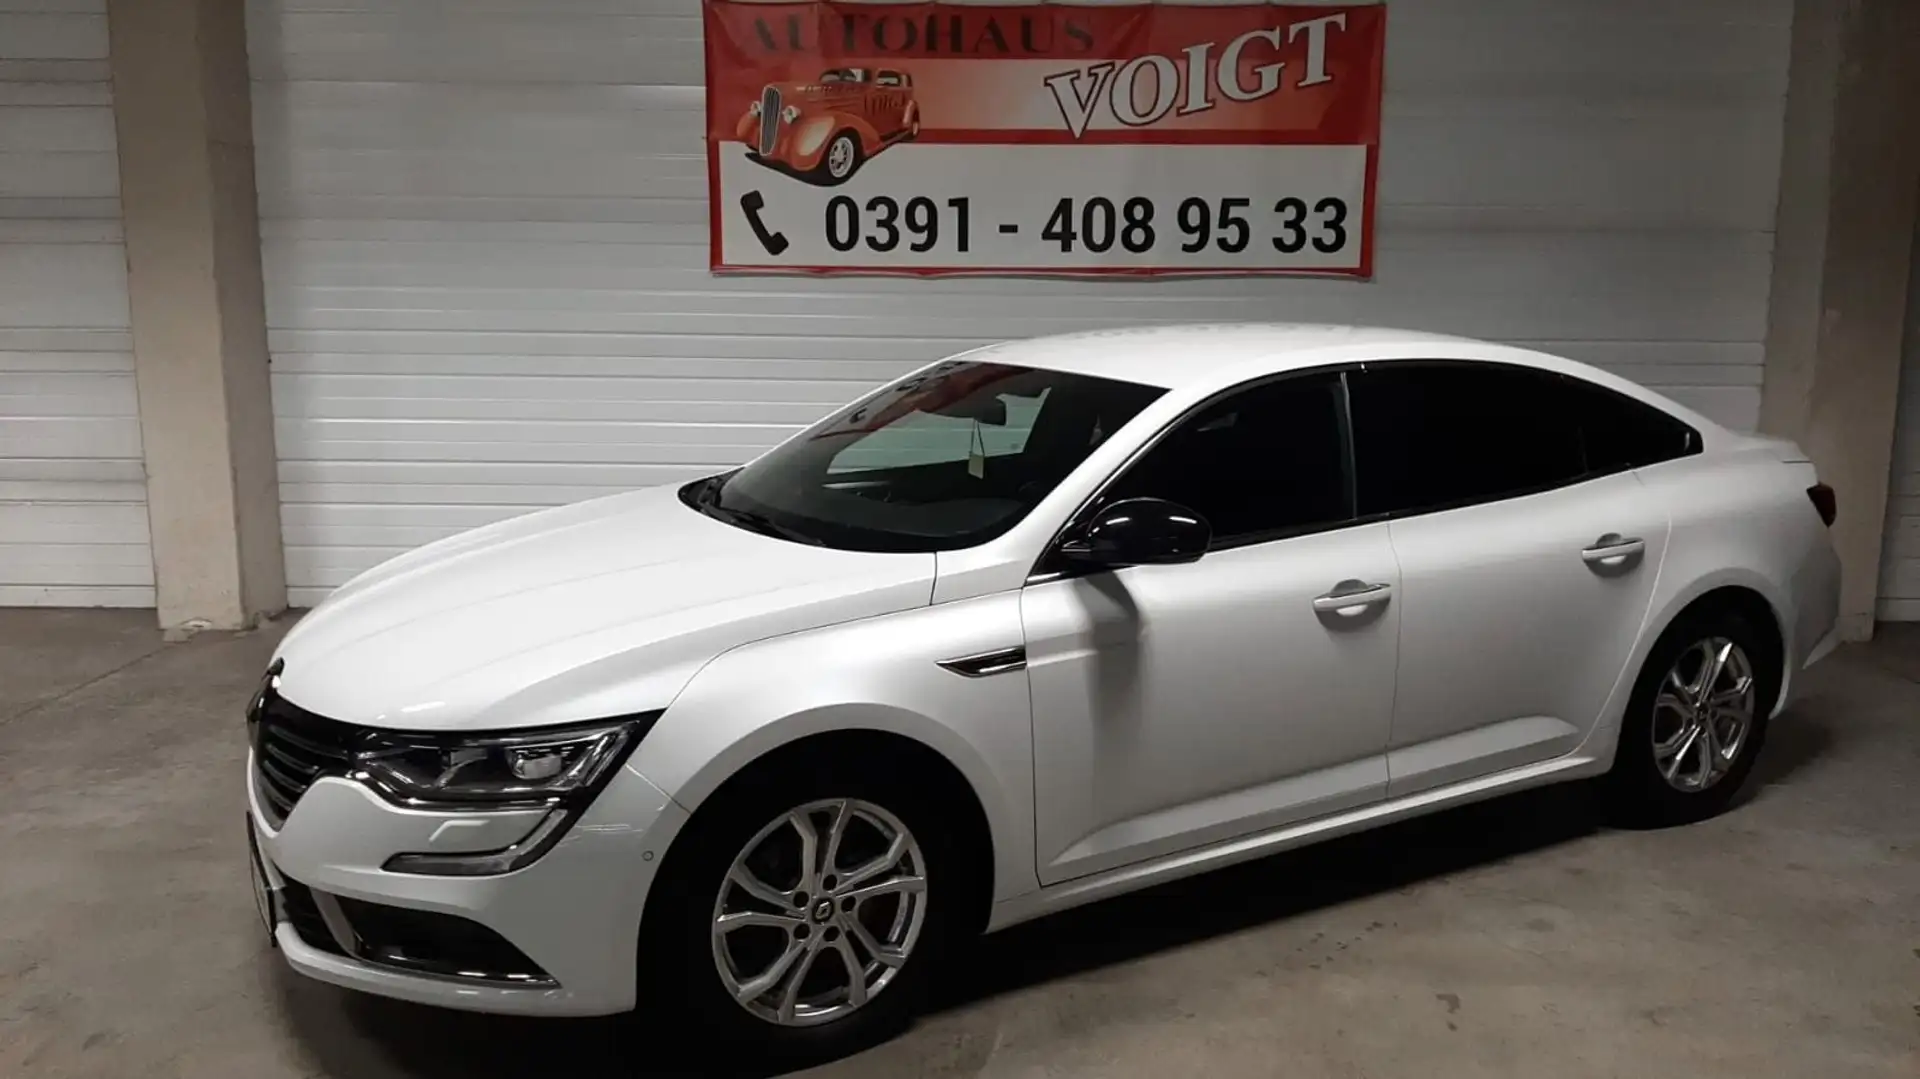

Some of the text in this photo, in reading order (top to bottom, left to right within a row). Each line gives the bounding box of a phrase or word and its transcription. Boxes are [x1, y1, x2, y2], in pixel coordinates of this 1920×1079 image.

[746, 14, 1095, 54] AUTOHAUS
[1044, 13, 1347, 138] VOIGT
[825, 196, 971, 253] 0391
[1041, 197, 1156, 253] 408
[1178, 197, 1251, 253] 95
[1271, 197, 1348, 253] 33
